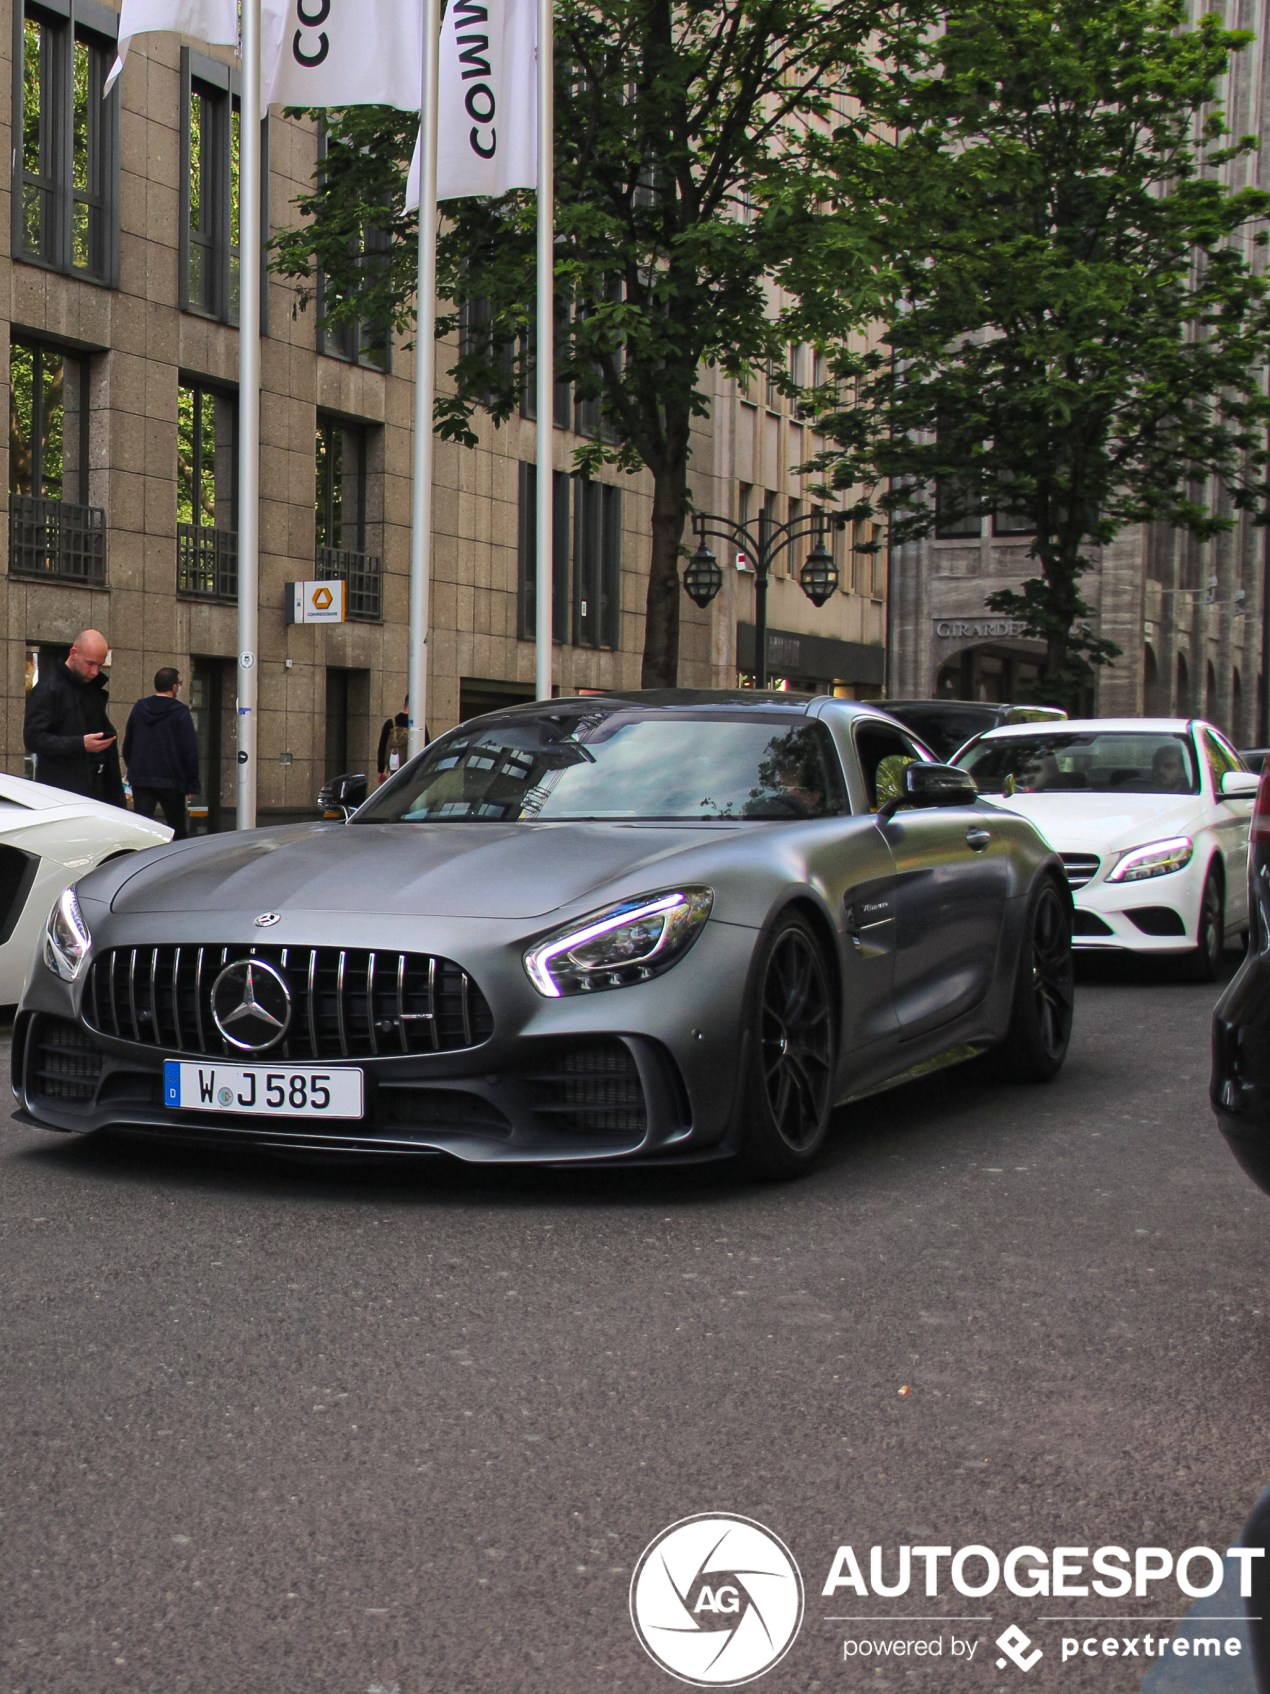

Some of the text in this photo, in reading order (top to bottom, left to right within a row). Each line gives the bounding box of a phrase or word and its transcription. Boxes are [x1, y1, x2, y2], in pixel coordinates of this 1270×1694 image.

[169, 1088, 177, 1099] D
[198, 1069, 331, 1109] W J 585
